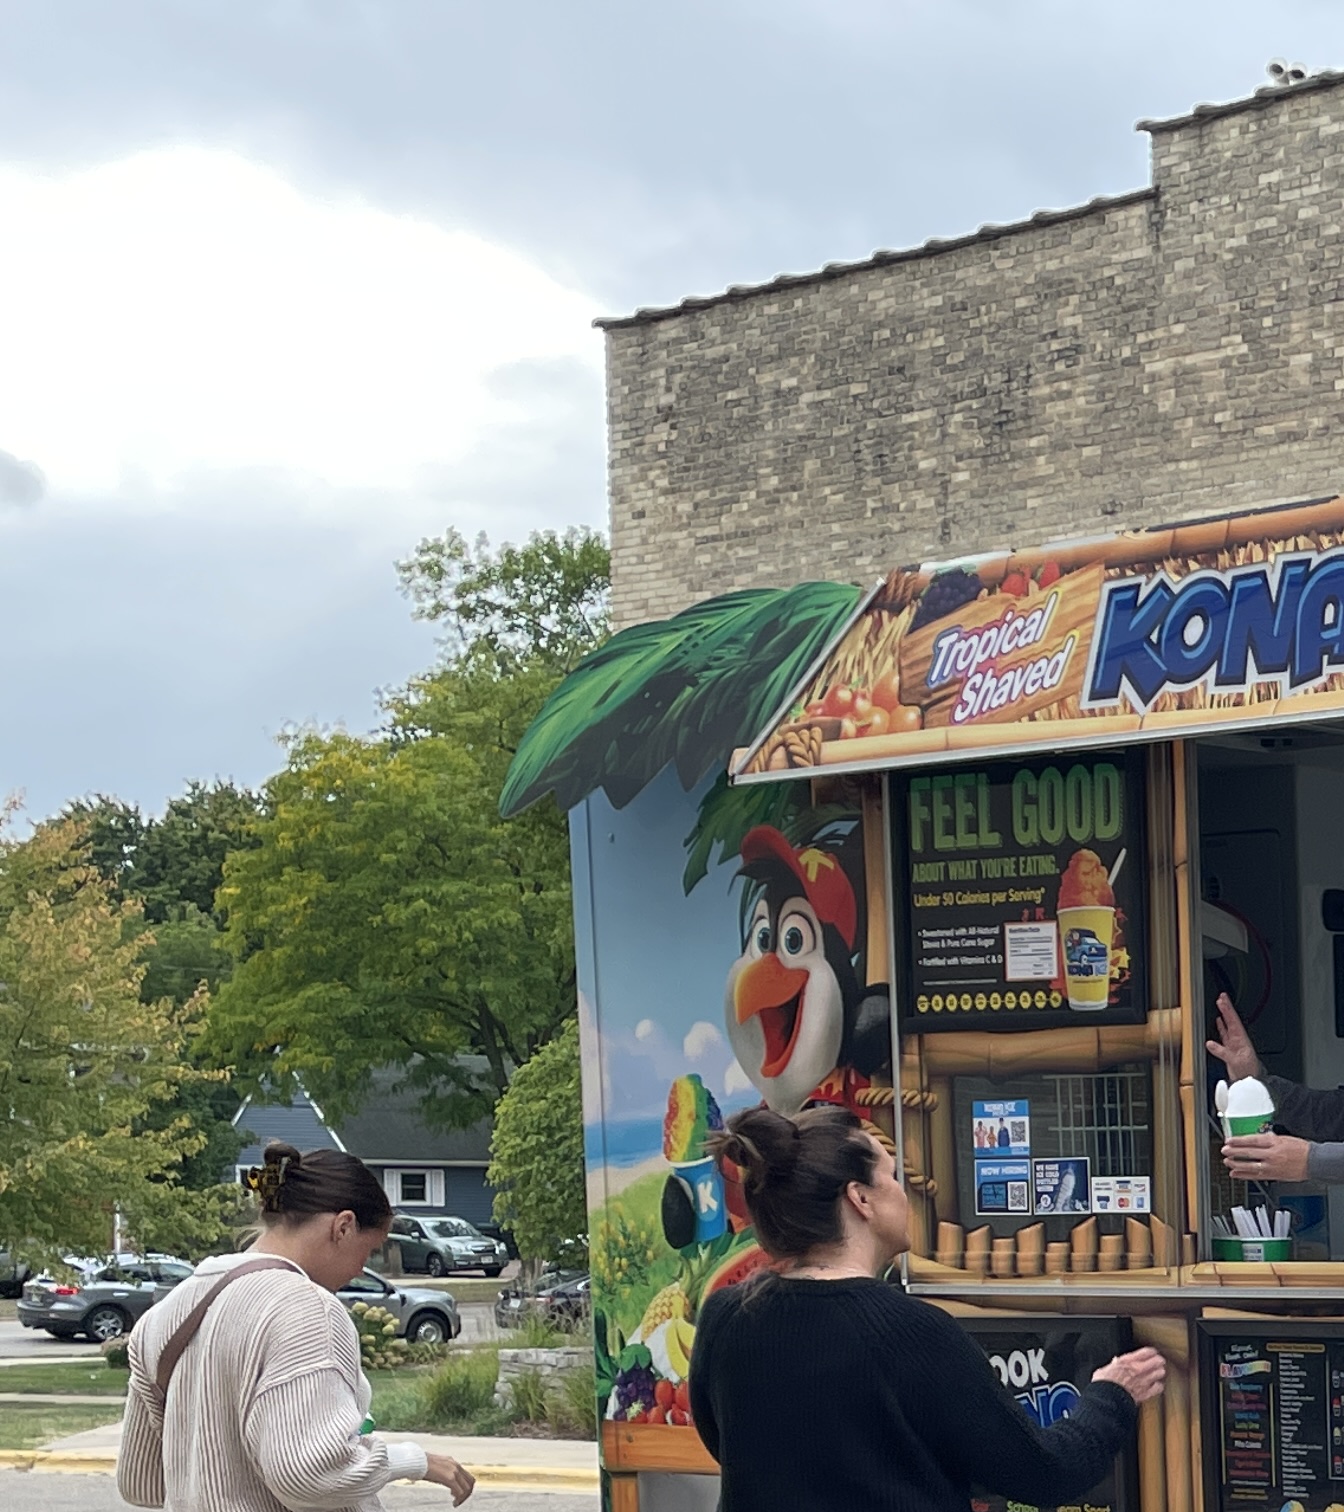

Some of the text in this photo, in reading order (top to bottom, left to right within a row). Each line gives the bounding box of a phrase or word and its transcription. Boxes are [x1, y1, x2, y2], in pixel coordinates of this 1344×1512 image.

[928, 587, 1060, 685] Tropical
[953, 632, 1076, 723] Shaved
[910, 763, 1124, 853] FEEL GOOD
[912, 855, 1060, 883] ABOUT WHAT YOU'RE EATING.
[914, 892, 940, 907] Under
[942, 892, 955, 906] 50
[955, 890, 990, 905] Calories
[697, 1180, 718, 1214] K
[989, 1347, 1049, 1388] OOK
